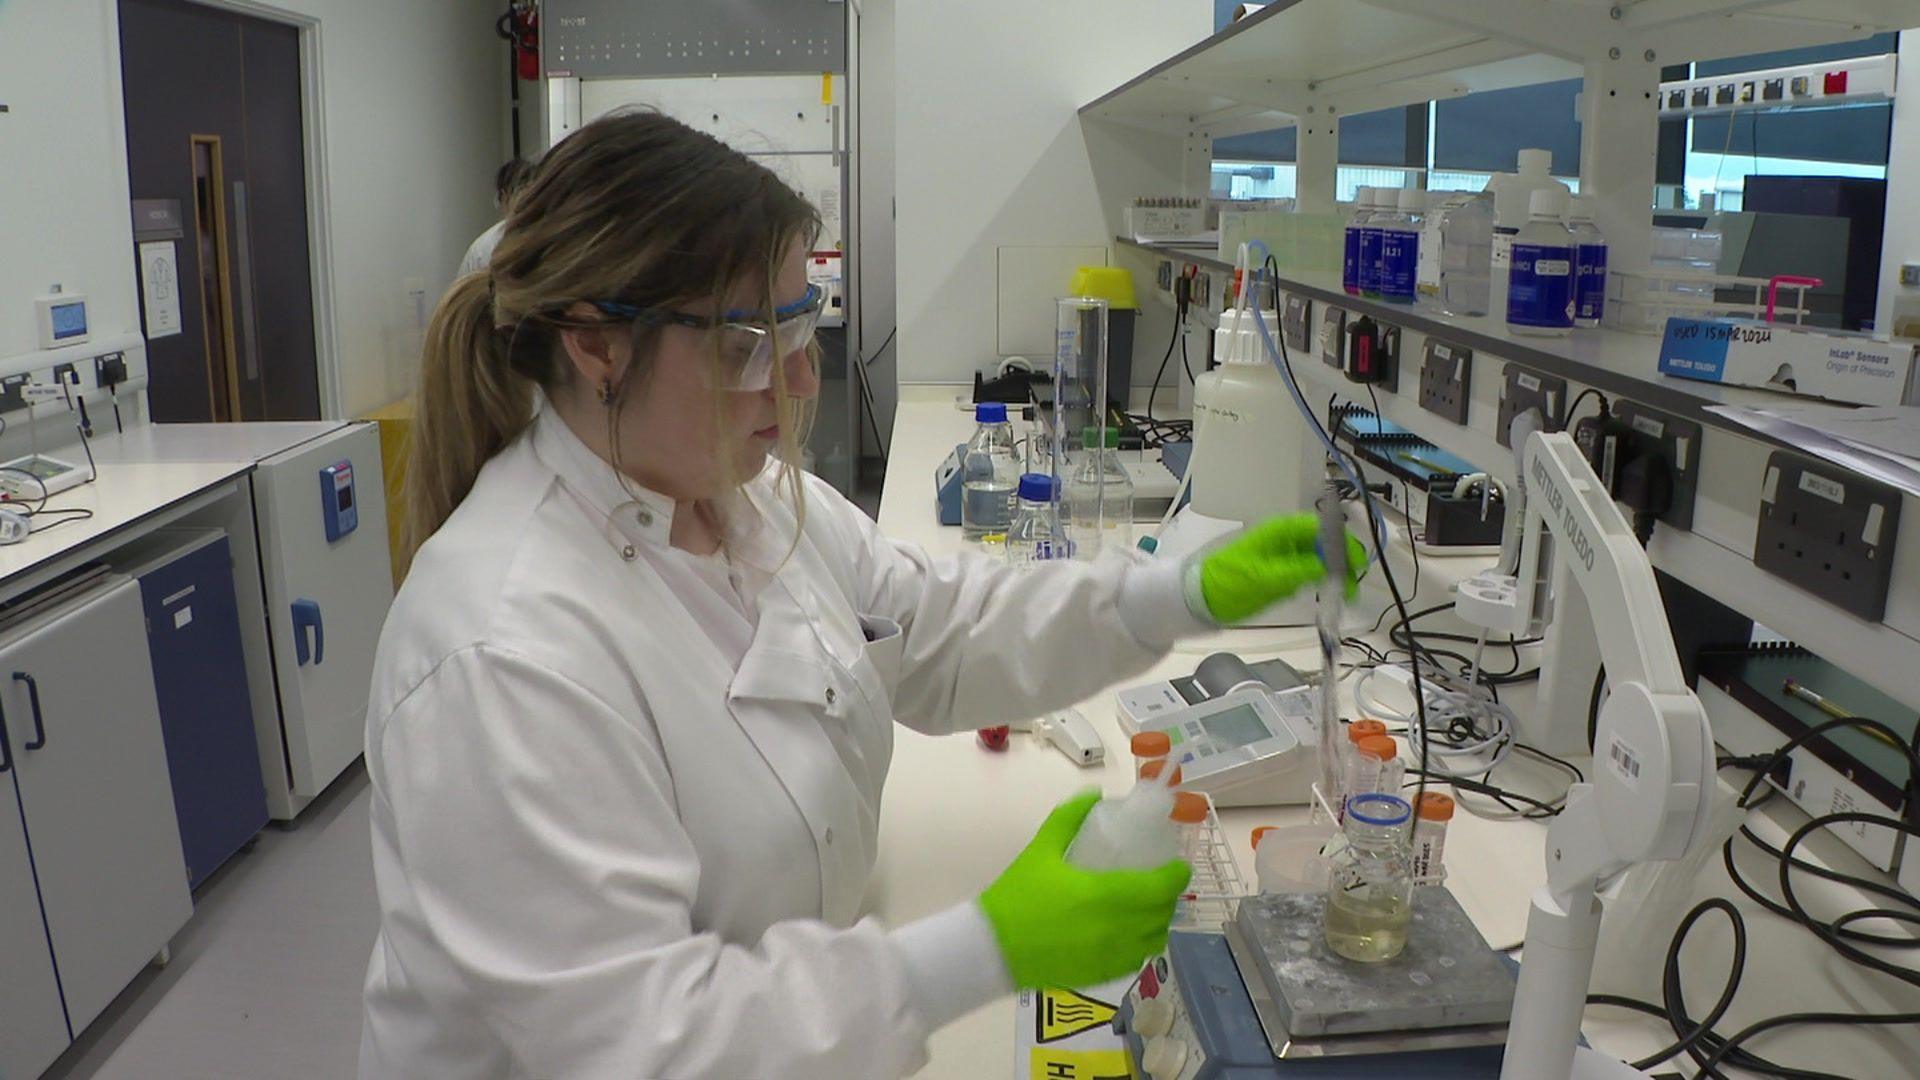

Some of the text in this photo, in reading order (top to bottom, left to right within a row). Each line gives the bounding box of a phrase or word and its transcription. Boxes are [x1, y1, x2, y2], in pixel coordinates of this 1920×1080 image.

[1856, 351, 1889, 365] Sensors
[1826, 360, 1895, 378] Origin of Precision
[1531, 453, 1594, 572] METTLER TOLEDO
